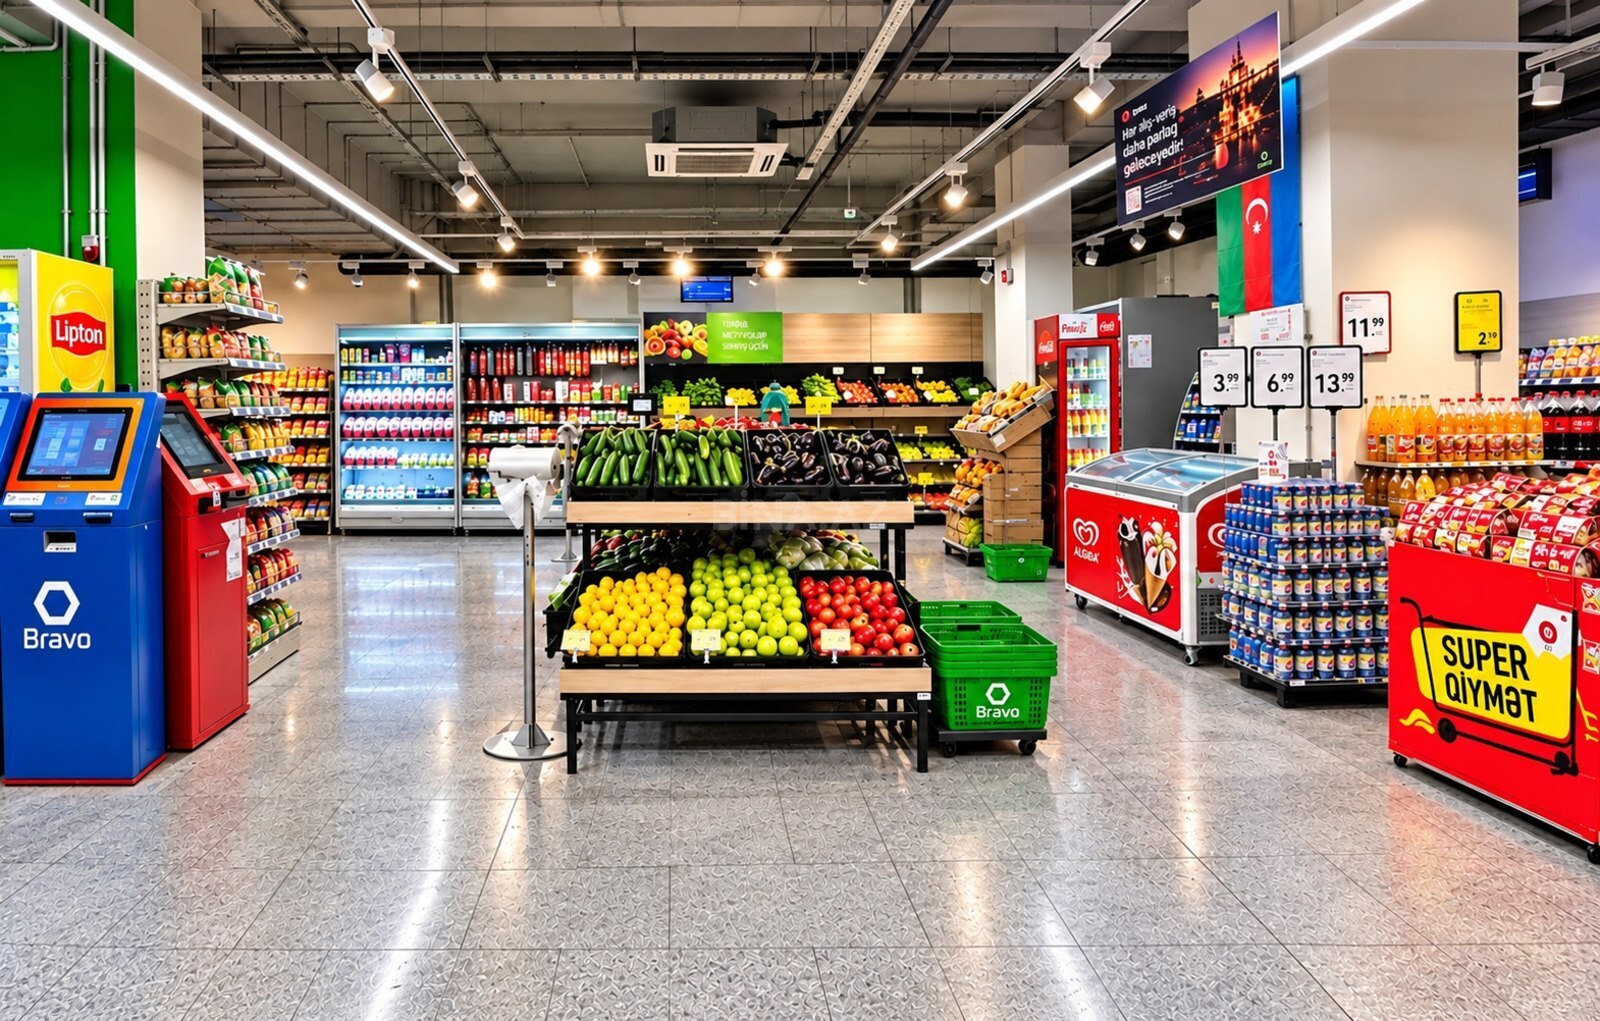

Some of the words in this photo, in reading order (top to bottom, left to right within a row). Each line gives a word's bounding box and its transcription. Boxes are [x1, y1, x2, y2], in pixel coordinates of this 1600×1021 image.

[55, 319, 104, 348] Lipton
[1348, 317, 1385, 338] 11.99
[1213, 373, 1239, 393] 3.99
[1267, 373, 1294, 393] 6.99
[1315, 373, 1355, 394] 13.99
[24, 627, 91, 649] Bravo
[1441, 634, 1530, 682] SUPER
[1445, 671, 1537, 723] QİYMƏT
[976, 705, 1020, 718] Bravo
